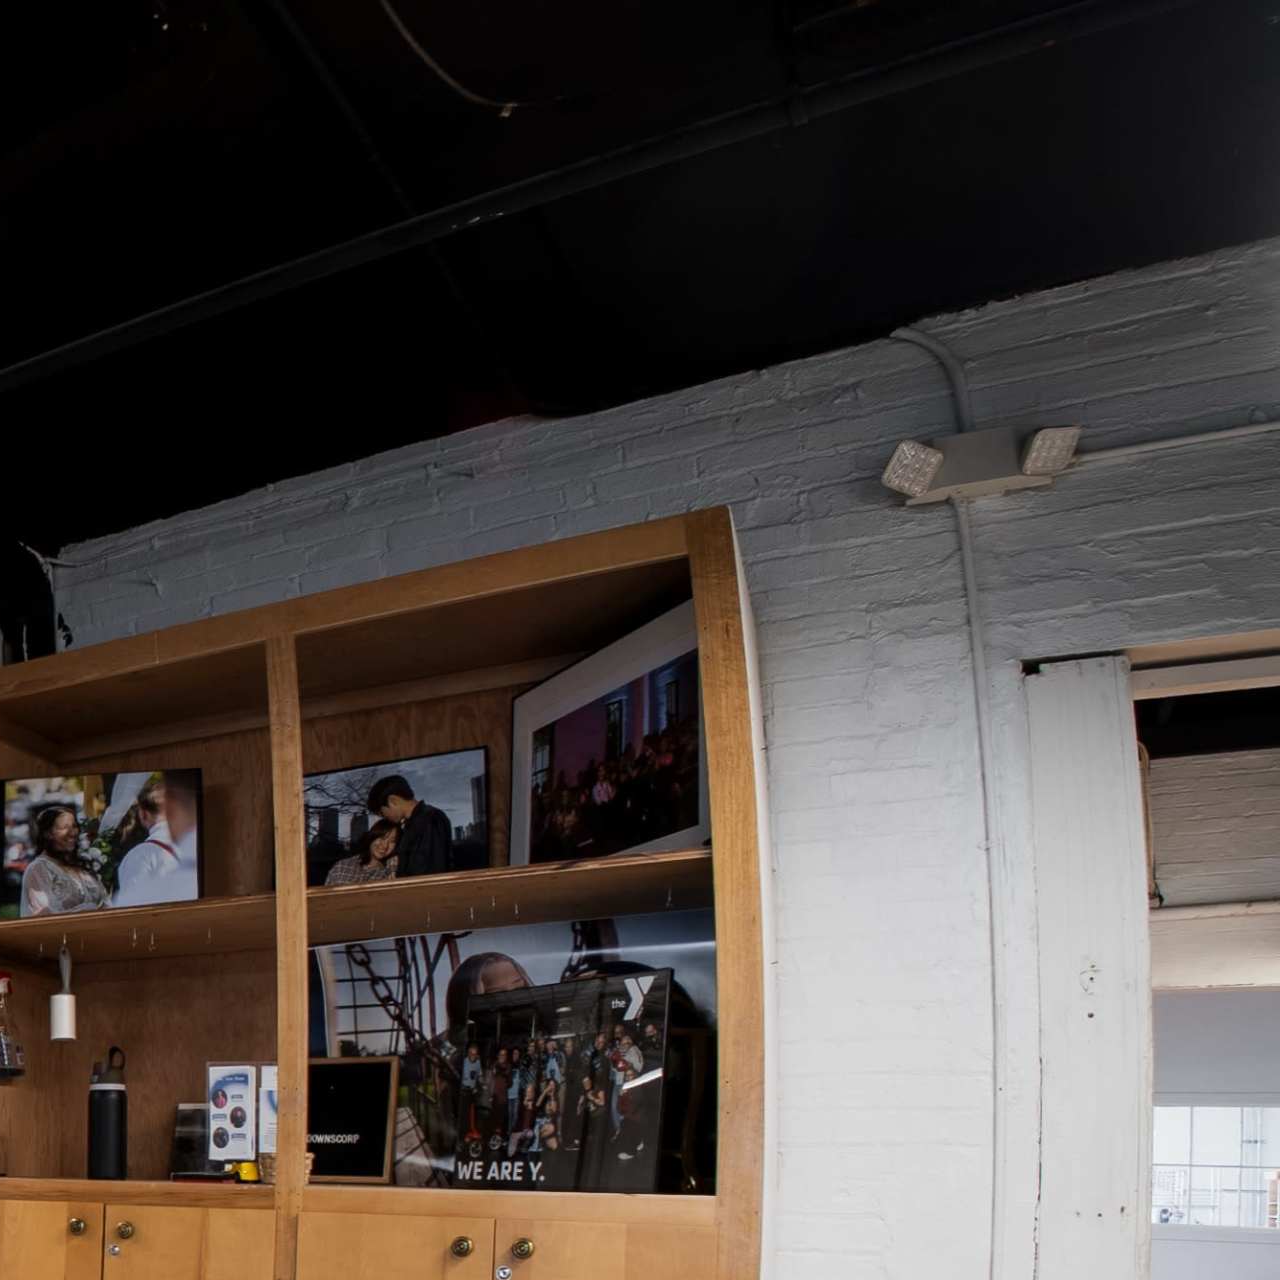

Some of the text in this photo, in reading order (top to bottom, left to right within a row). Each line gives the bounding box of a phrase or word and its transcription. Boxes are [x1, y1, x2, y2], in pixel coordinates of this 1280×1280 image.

[611, 996, 627, 1010] the
[457, 1159, 546, 1183] WE ARE Y.
